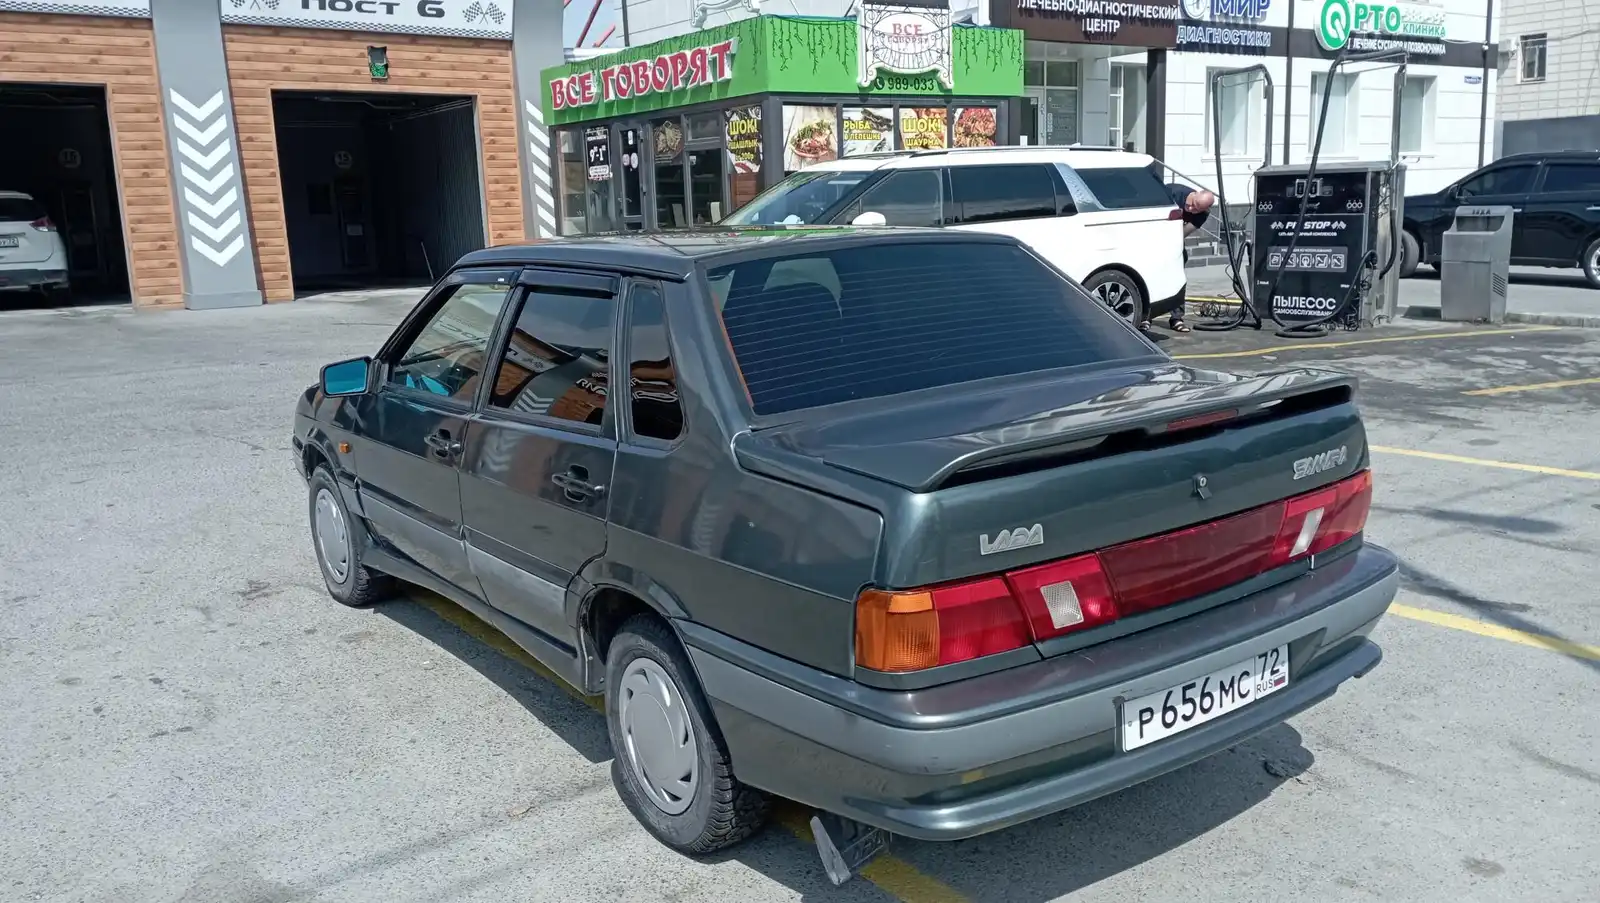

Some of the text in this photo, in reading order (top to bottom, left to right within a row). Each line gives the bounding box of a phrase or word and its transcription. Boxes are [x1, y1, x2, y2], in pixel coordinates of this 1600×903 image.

[299, 0, 446, 18] ПОСТ 6
[1020, 0, 1178, 19] ЛЕЧЕБНО-ДИАГНОСТИЧЕСКИЙ
[1213, 0, 1270, 18] МИР
[892, 23, 922, 36] ВСЕ
[1086, 19, 1120, 33] ЦЕНТР
[1403, 24, 1446, 36] КЛИНИКА
[1176, 25, 1271, 47] ДИАГНОСТИКИ
[550, 41, 733, 110] ВСЕ ГОВОРЯТ
[888, 77, 934, 91] 989-033
[729, 119, 758, 135] ШОК!
[843, 120, 871, 130] РЫБА
[902, 118, 941, 133] ШОК!
[905, 138, 939, 147] ШАУРМА
[1304, 221, 1331, 229] STOP
[1273, 295, 1336, 310] ПЫЛЕСОС
[980, 523, 1044, 555] LADA
[1257, 648, 1280, 680] 72
[1256, 679, 1274, 693] RUS
